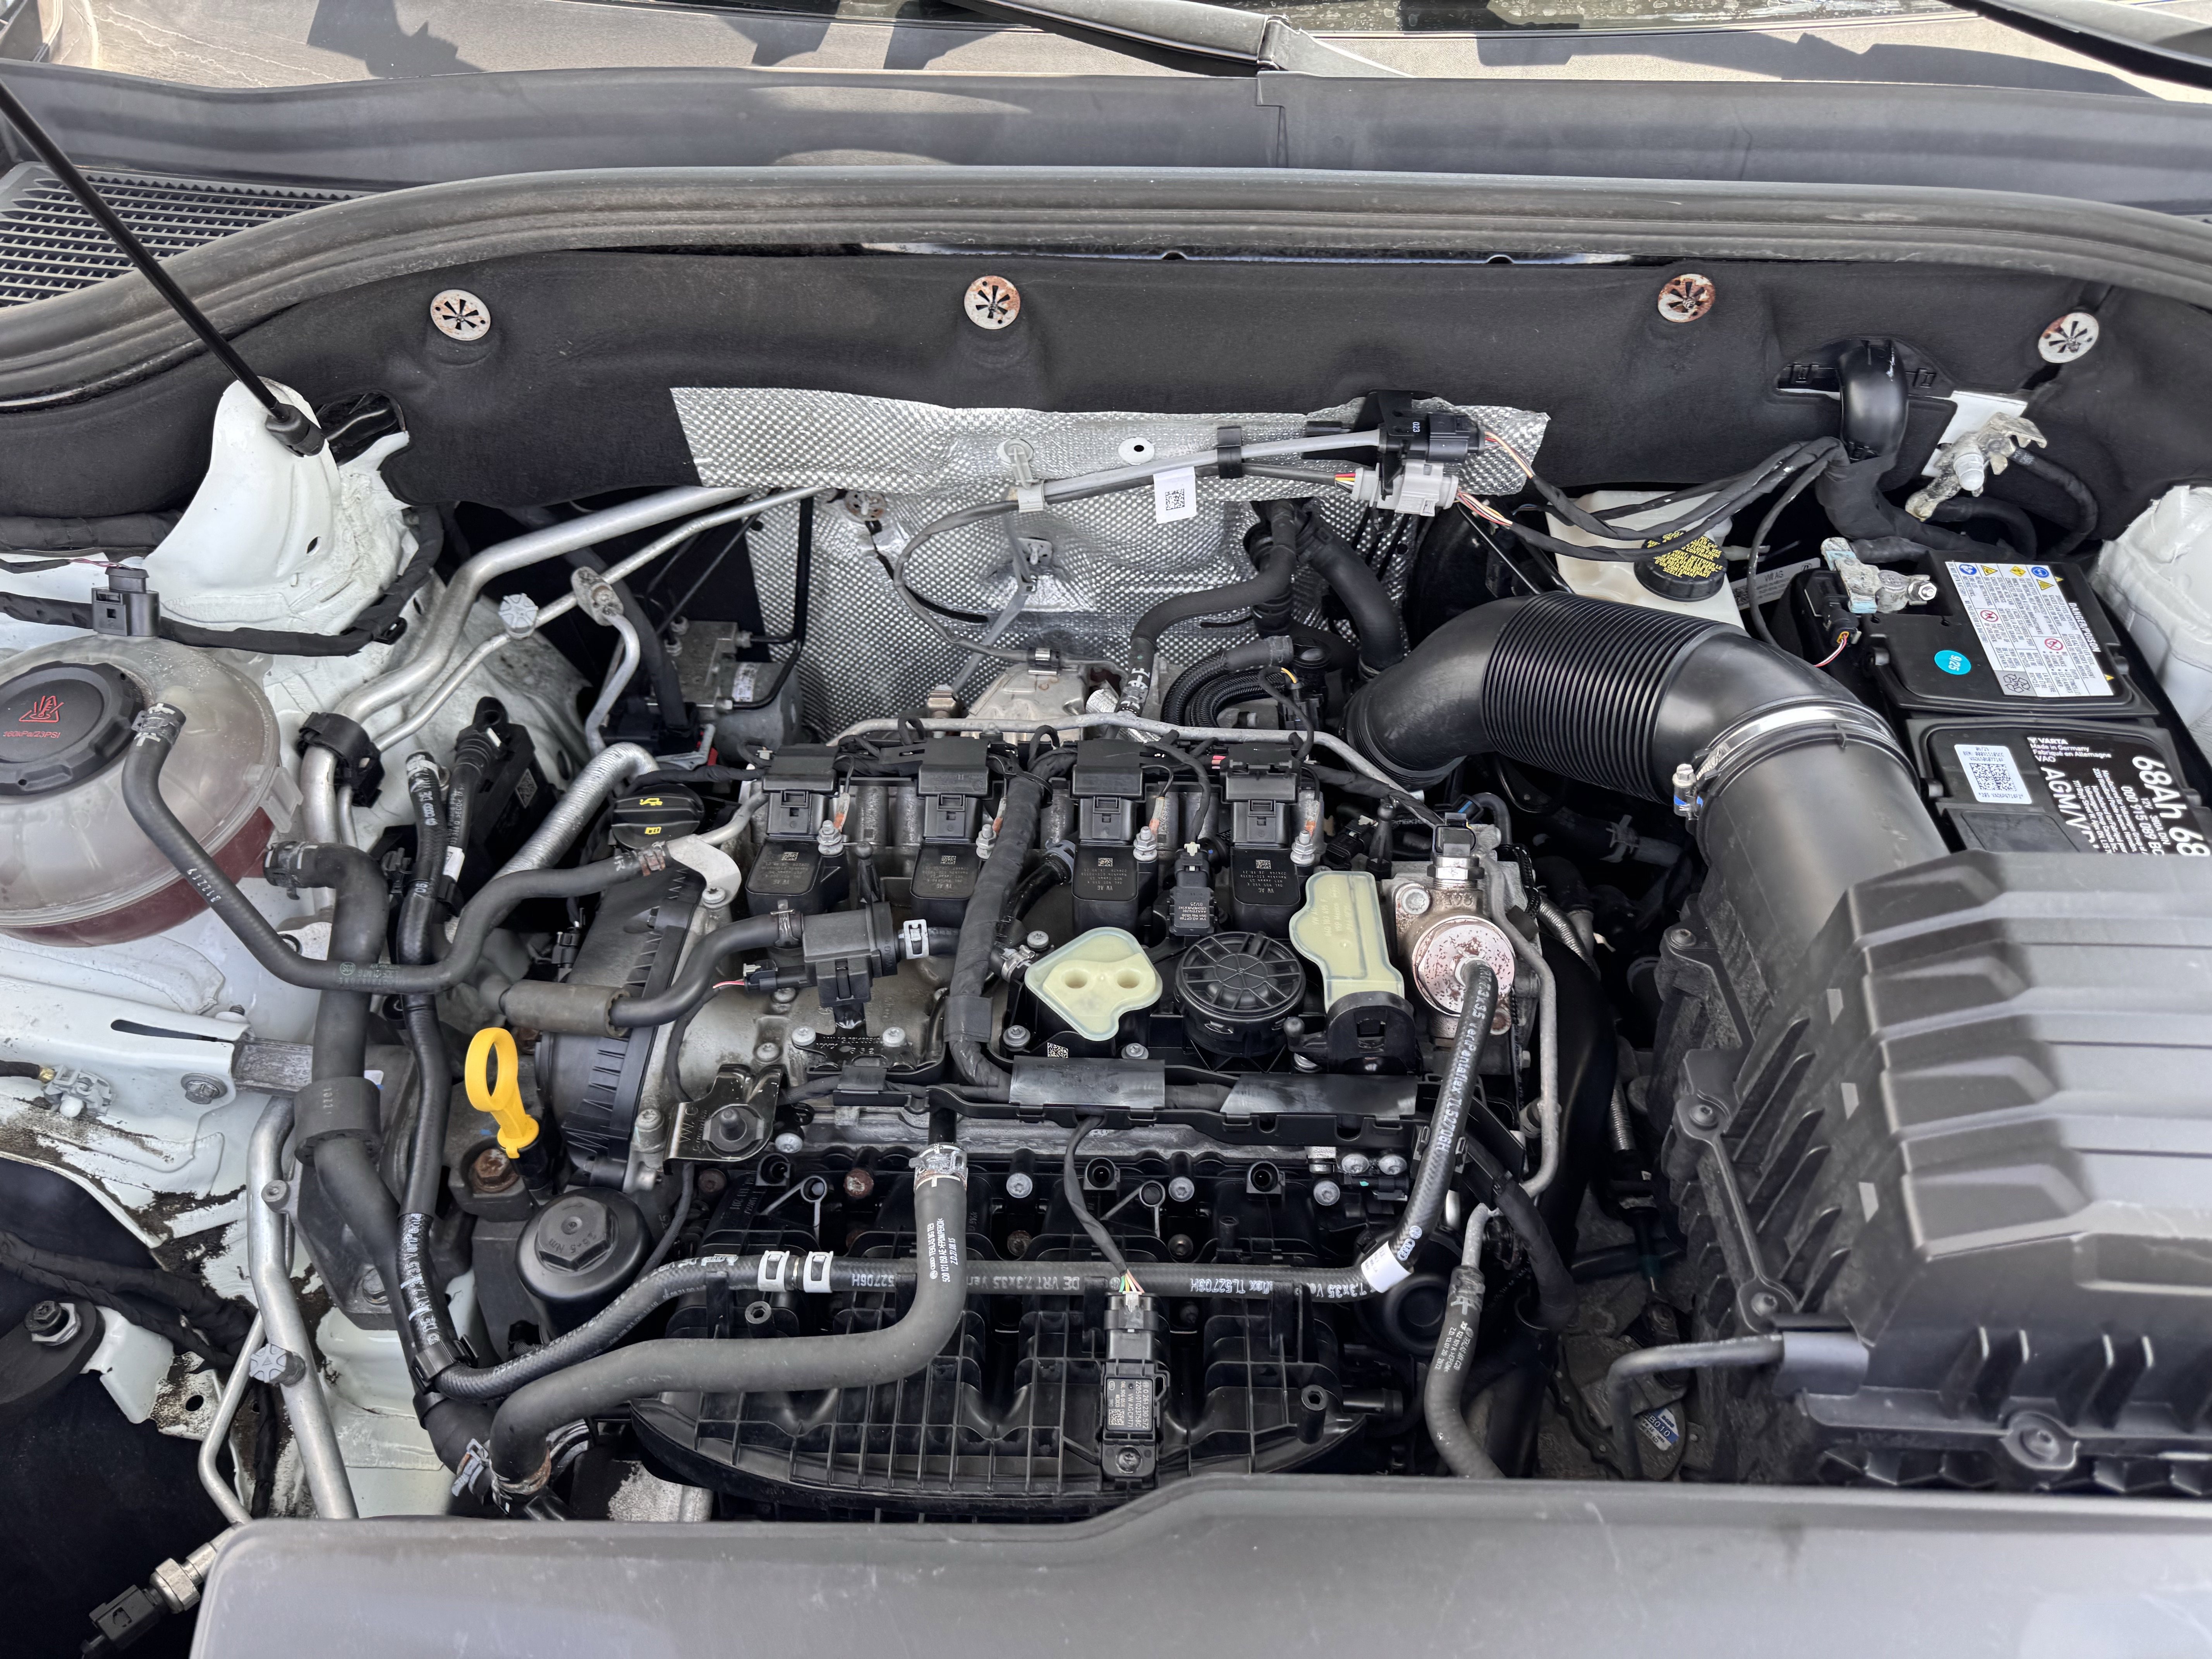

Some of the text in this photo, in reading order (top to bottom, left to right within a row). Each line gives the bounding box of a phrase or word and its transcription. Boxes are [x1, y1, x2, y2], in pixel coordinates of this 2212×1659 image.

[2068, 603, 2101, 652] DANGER/POISON
[1948, 655, 1962, 670] 9/25
[2040, 766, 2100, 849] AGM/V
[2132, 756, 2188, 819] 68Ah
[2121, 786, 2138, 803] 000
[2130, 804, 2147, 821] 915
[2139, 822, 2157, 840] 089
[2141, 797, 2171, 845] 12V 380A DIN
[1436, 1098, 1462, 1153] TL52706H
[928, 1238, 936, 1257] TEKLAS
[1036, 1276, 1080, 1290] DE VRT
[1128, 1393, 1133, 1402] VW
